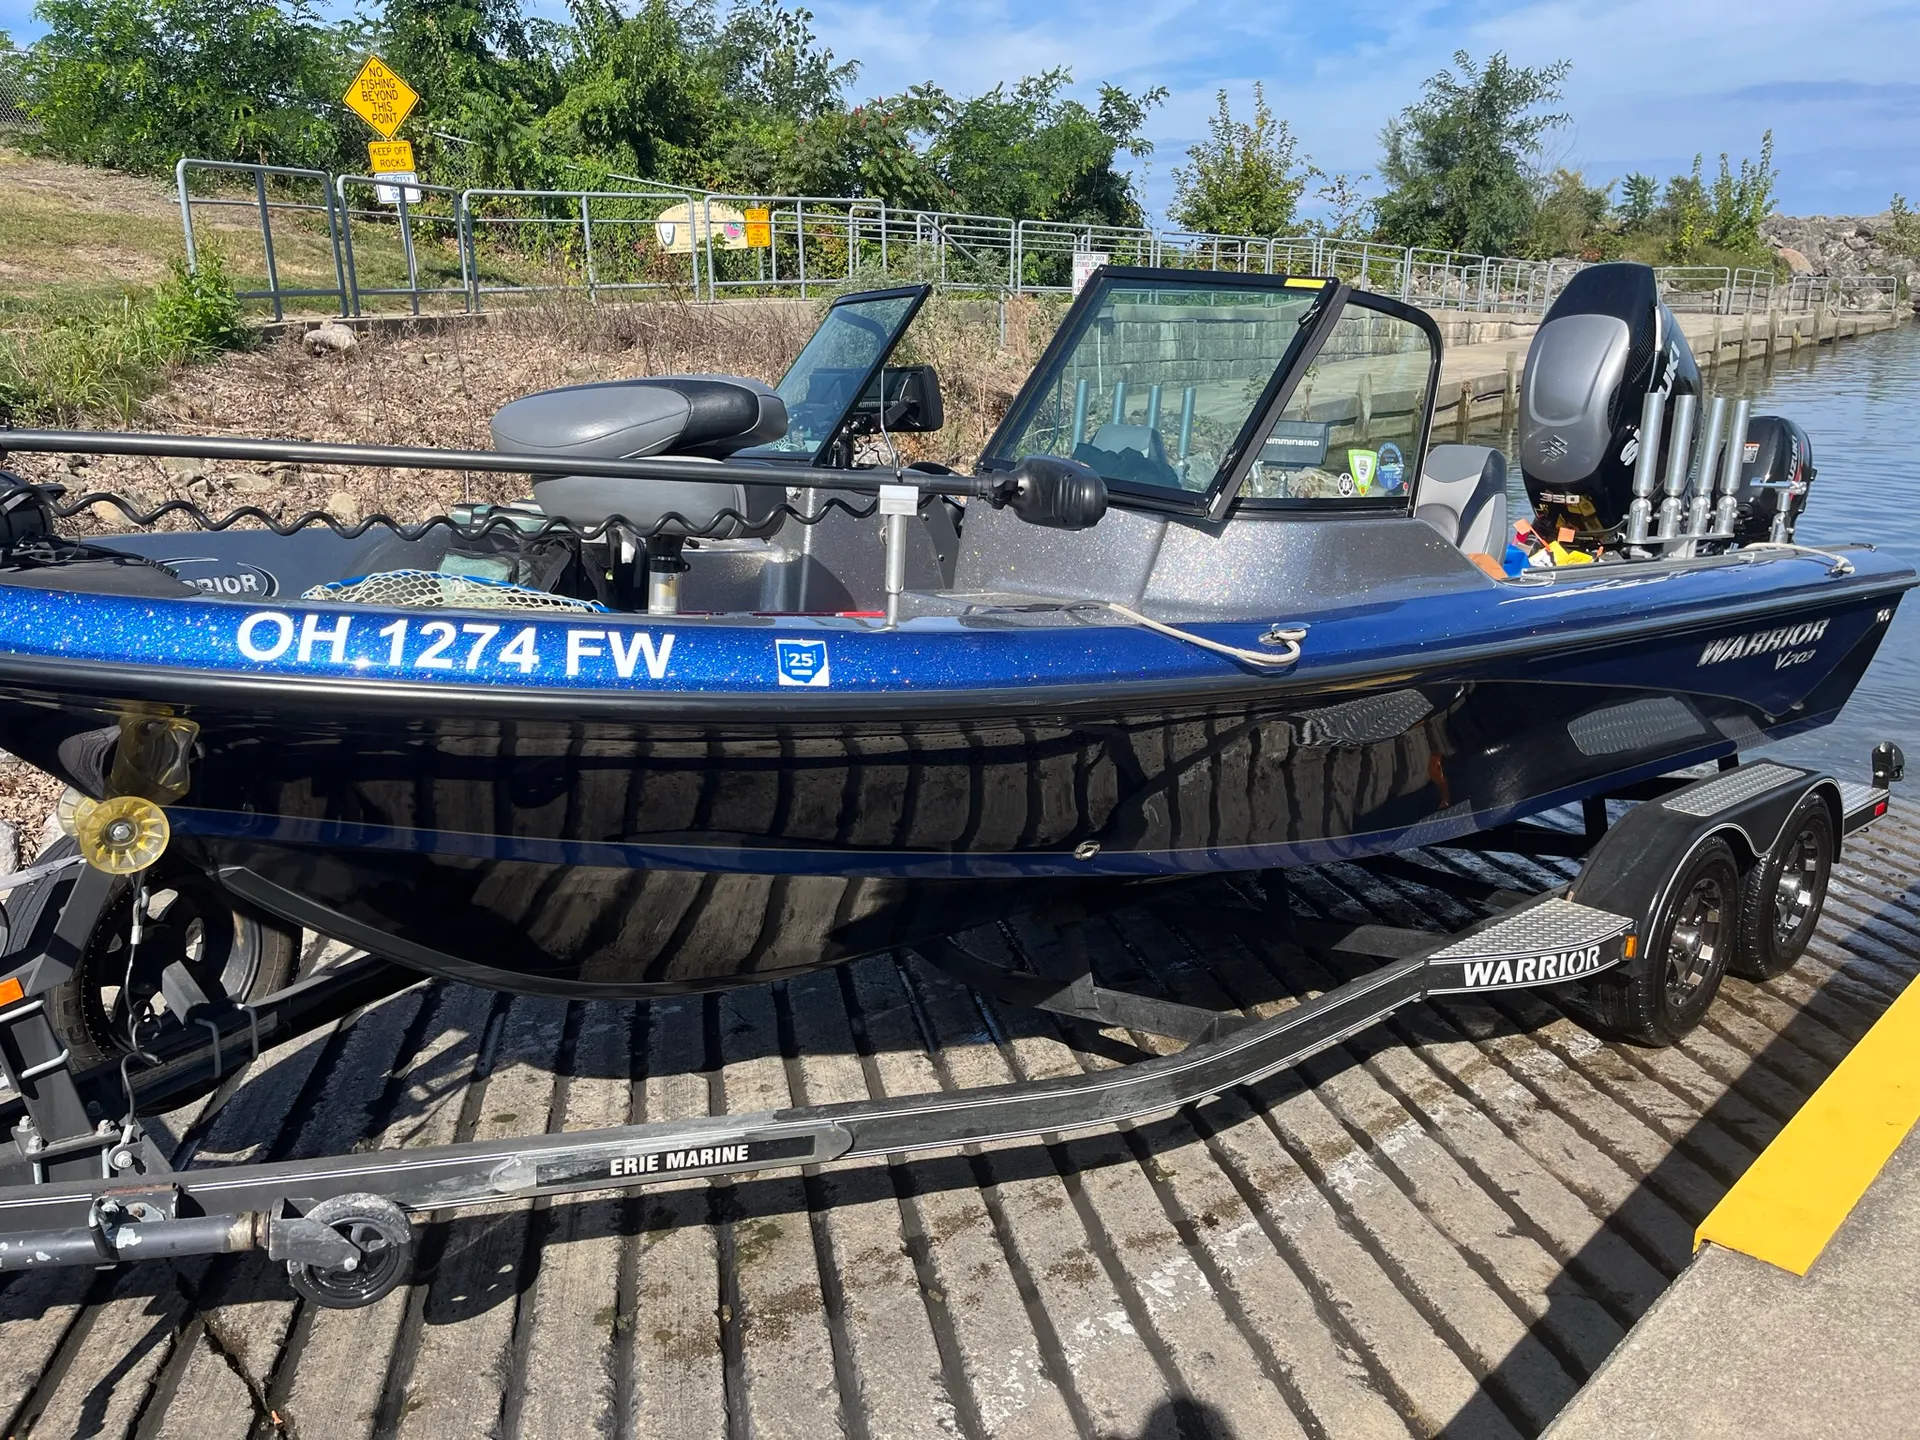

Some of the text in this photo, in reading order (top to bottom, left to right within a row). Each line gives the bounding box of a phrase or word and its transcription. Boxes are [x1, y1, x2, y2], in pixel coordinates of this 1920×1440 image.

[368, 67, 383, 78] NO
[360, 78, 396, 89] FISHING
[362, 90, 398, 102] BEYOND
[372, 102, 393, 112] THIS
[371, 113, 398, 124] POINT
[372, 145, 407, 156] KEEP OFF
[380, 158, 406, 168] ROCKS
[1620, 341, 1680, 466] SUKI
[1266, 437, 1320, 447] UMMINBIRD
[1787, 434, 1799, 483] UZUKI
[1539, 492, 1580, 504] 350
[181, 573, 260, 595] RIOR
[236, 612, 676, 679] OH 1274 FW
[1696, 617, 1831, 667] WARRIOR
[788, 652, 814, 667] 25
[1463, 945, 1601, 987] WARRIOR
[609, 1144, 750, 1177] ERIE MARINE
